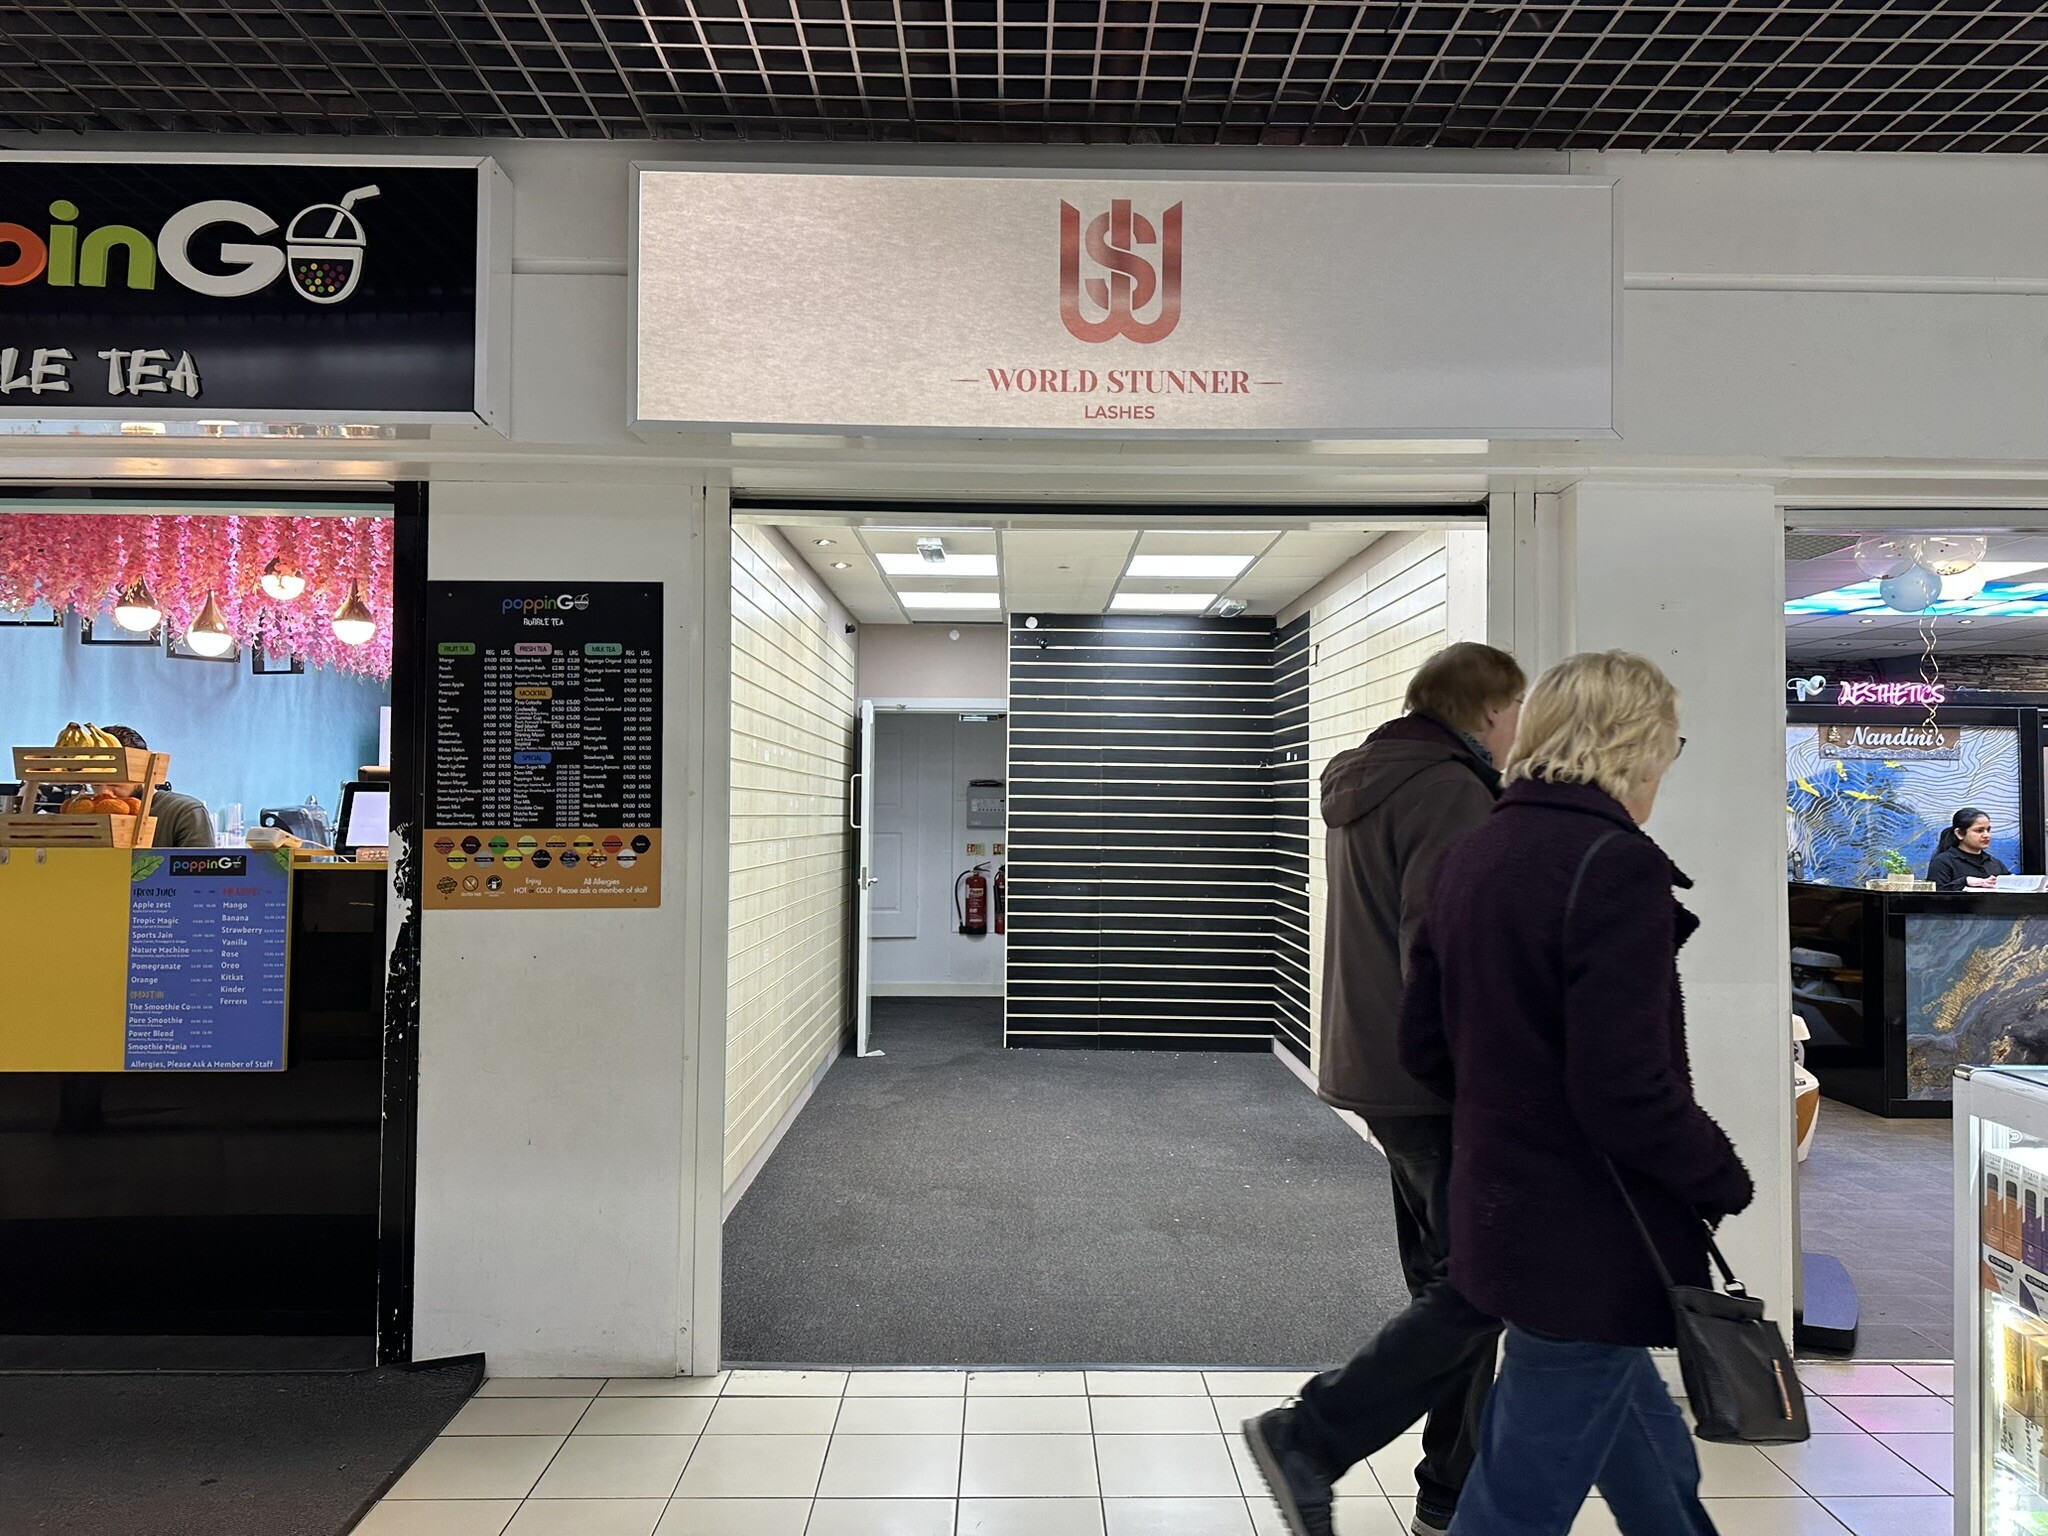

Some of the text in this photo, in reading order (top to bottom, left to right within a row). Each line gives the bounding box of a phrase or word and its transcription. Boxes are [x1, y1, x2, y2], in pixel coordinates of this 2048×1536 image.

[98, 348, 202, 399] TEA
[986, 368, 1250, 395] WORLD STUNNER
[1085, 405, 1155, 420] LASHES
[1838, 681, 1945, 705] AESTHETICS
[1846, 726, 1945, 747] Nandini's
[526, 877, 541, 886] Enjoy
[593, 877, 620, 886] Allergies
[557, 886, 578, 894] Please
[580, 886, 590, 894] ask
[133, 901, 154, 909] Apple
[223, 902, 247, 910] Mango
[133, 917, 178, 926] Tropic Magic
[222, 926, 262, 935] Strawberry
[132, 931, 172, 940] Sports Jain
[222, 938, 247, 946] Vanilla
[132, 963, 181, 971] Pomegranate
[131, 976, 158, 985] Orange
[221, 973, 243, 981] Kitkat
[221, 985, 245, 993] Kinder
[131, 1060, 165, 1069] Allergies,
[167, 1060, 191, 1068] Please
[214, 1060, 244, 1068] Member
[246, 1060, 254, 1068] of
[255, 1060, 273, 1068] Staff
